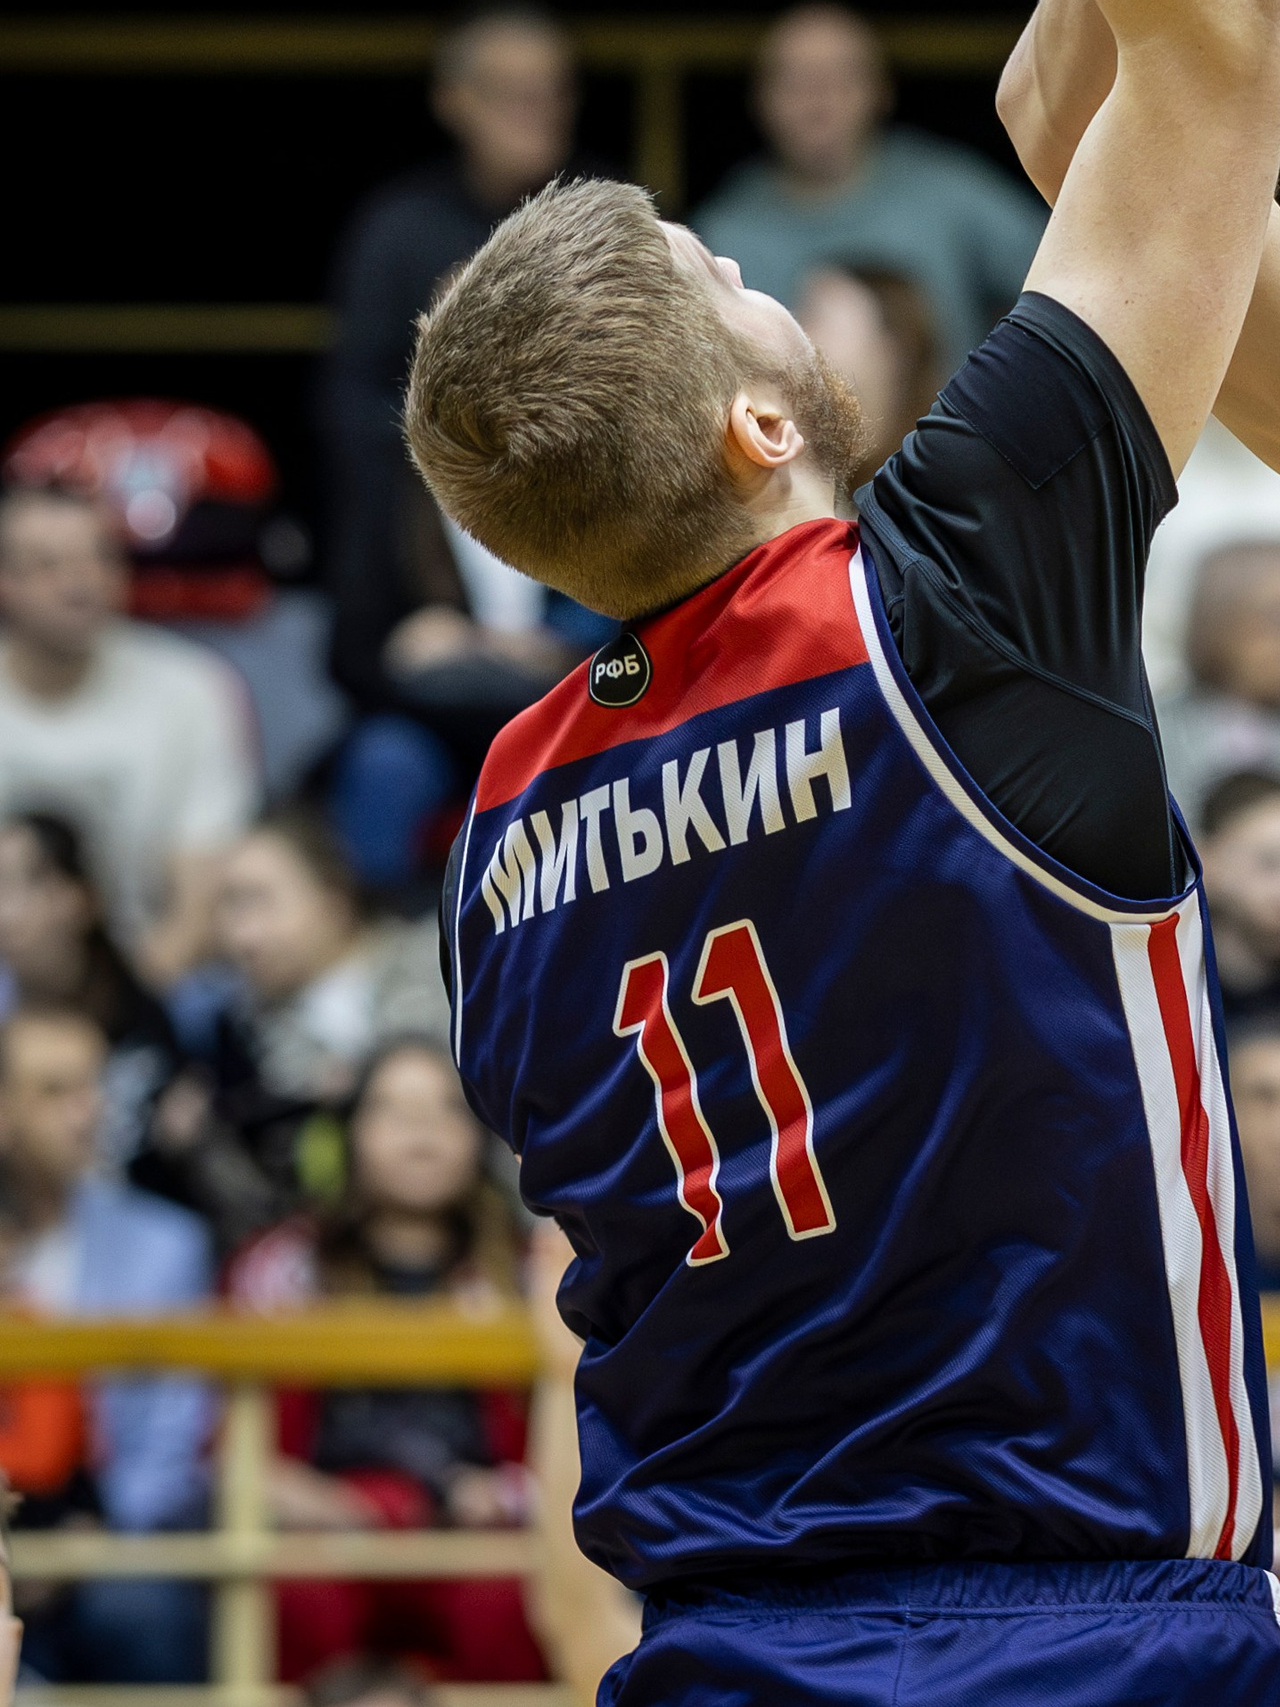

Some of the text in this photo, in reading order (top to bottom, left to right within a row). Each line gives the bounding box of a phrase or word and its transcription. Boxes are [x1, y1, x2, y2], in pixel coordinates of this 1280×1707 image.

[595, 654, 641, 685] РФБ
[481, 706, 852, 936] МИТЬКИН
[612, 918, 837, 1268] 11
